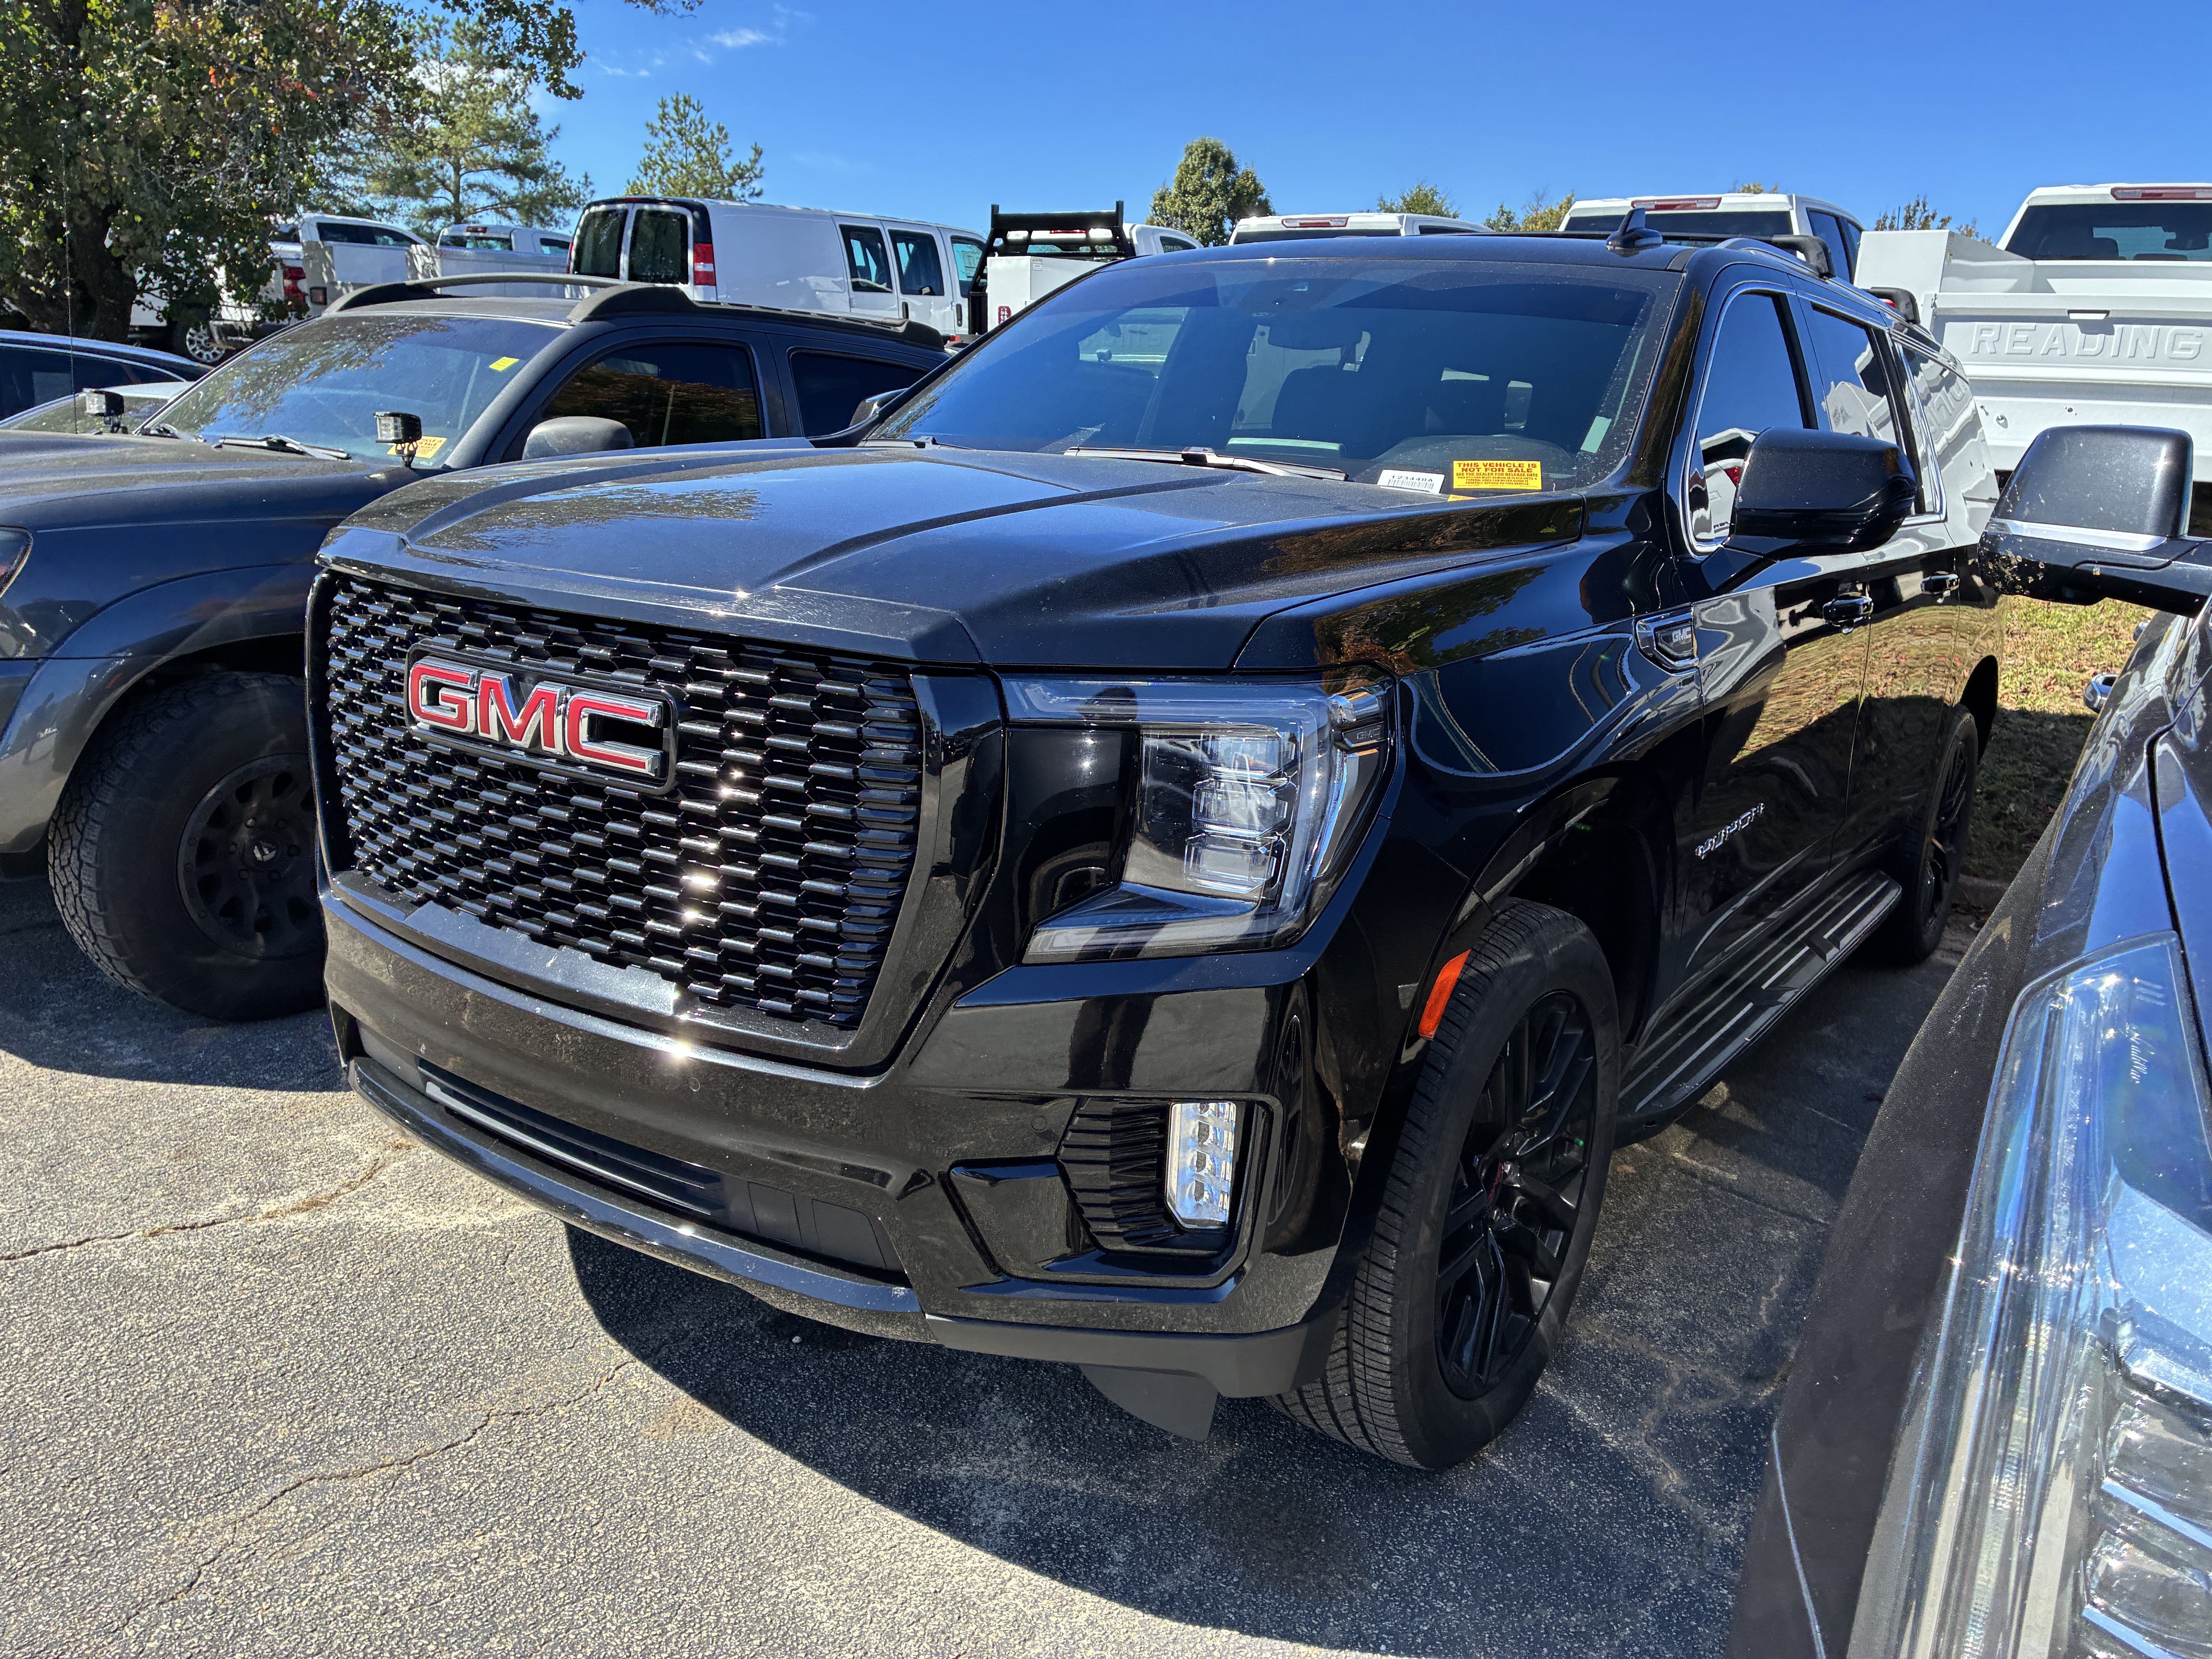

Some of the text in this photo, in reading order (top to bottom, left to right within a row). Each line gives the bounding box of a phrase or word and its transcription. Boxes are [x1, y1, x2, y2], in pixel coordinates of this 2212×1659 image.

[1971, 322, 2202, 360] READING
[1672, 627, 1692, 642] GMC
[409, 656, 663, 777] GMC
